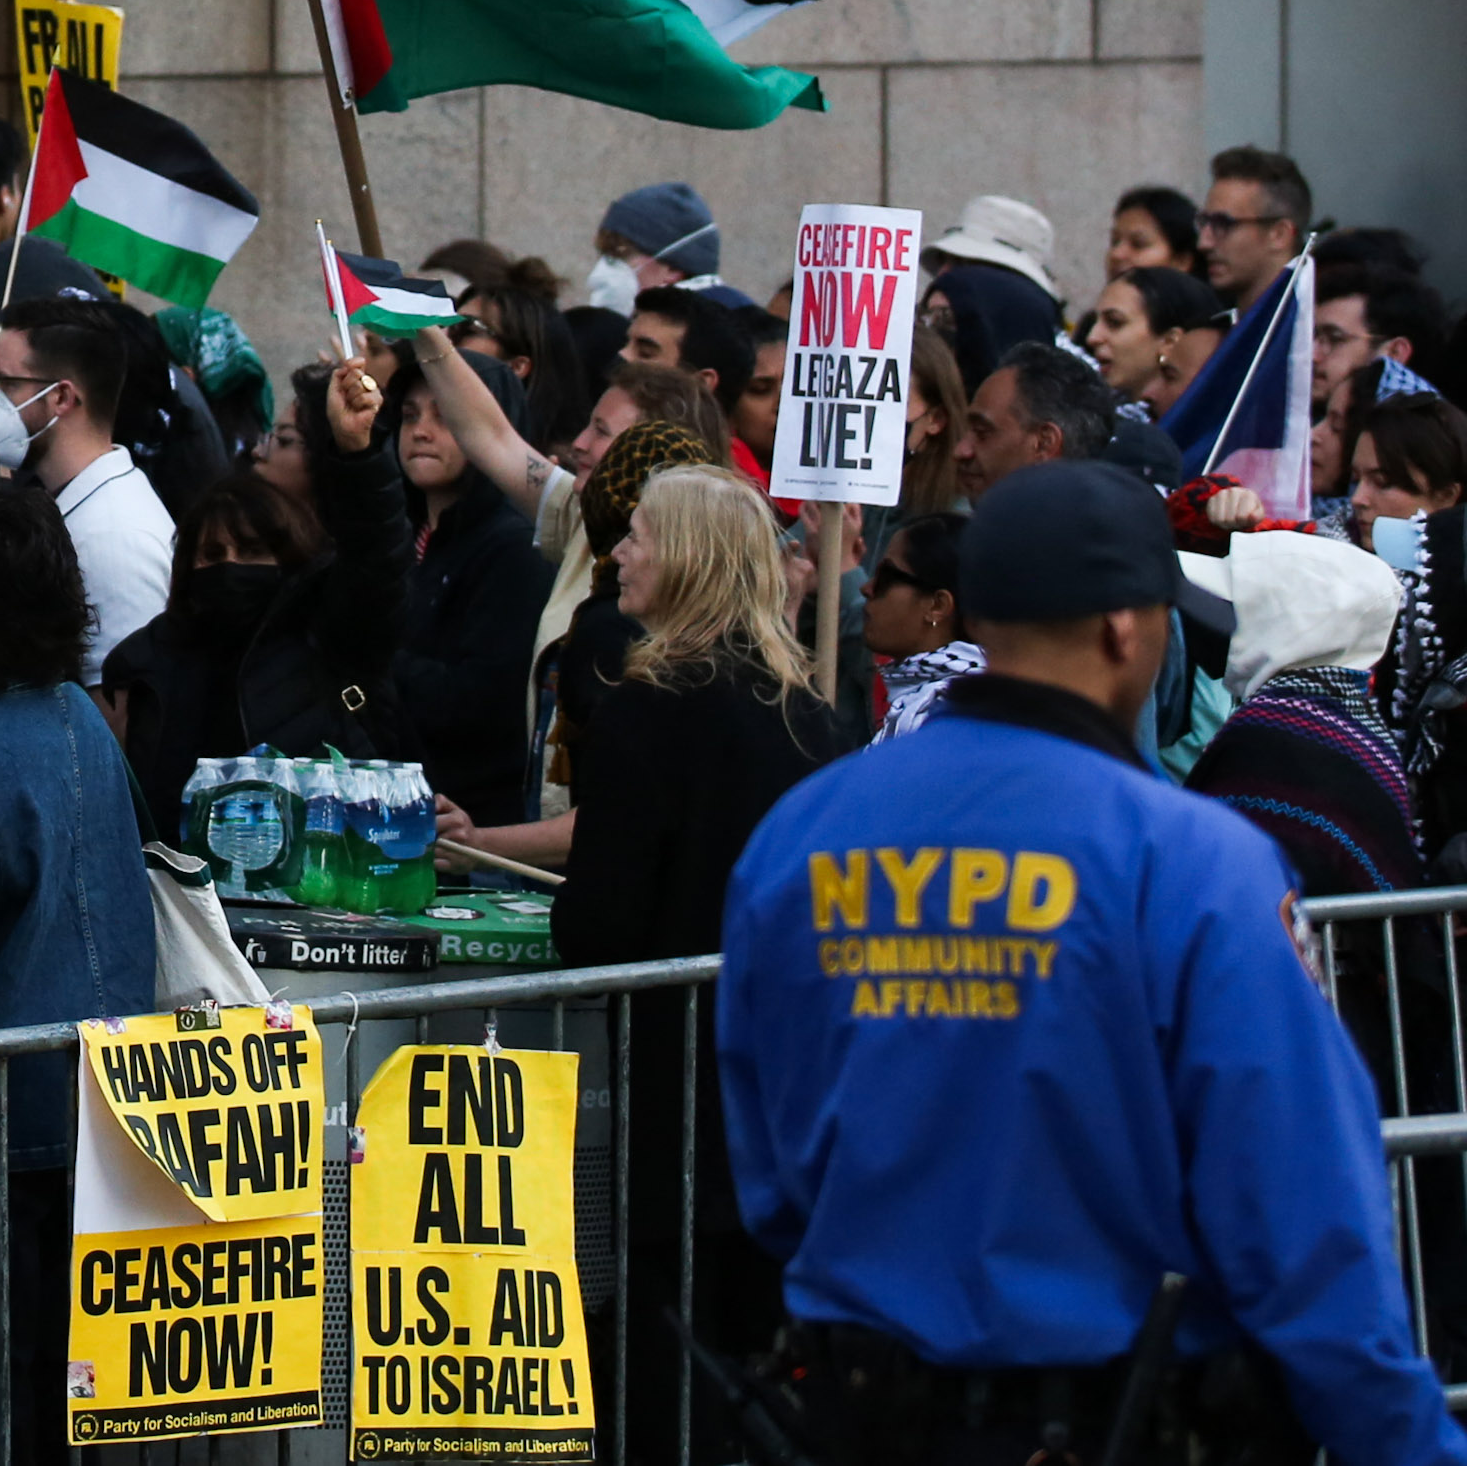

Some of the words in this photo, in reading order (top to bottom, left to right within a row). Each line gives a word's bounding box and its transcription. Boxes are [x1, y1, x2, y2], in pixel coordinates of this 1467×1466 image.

[798, 223, 913, 271] CEASEFIRE
[799, 270, 898, 350] NOW
[823, 353, 902, 402] GAZA
[799, 401, 877, 470] LVE!
[809, 847, 1077, 931] NYPD
[291, 940, 355, 964] Don't
[362, 944, 408, 965] litter
[442, 934, 564, 962] Recycl
[819, 936, 1058, 978] COMMUNITY
[850, 980, 1020, 1019] AFFAIRS
[103, 1036, 237, 1104] HANDS
[242, 1030, 308, 1093] OFF
[408, 1054, 524, 1148] END
[123, 1100, 311, 1198] RAFAH!
[414, 1152, 525, 1247] ALL
[80, 1234, 316, 1316] CEASEFIRE
[366, 1266, 469, 1346] U.S.
[489, 1267, 565, 1348] AID
[128, 1311, 273, 1398] NOW!
[363, 1356, 414, 1415] TO
[421, 1356, 578, 1416] ISRAEL!
[103, 1418, 140, 1435] Party
[144, 1417, 162, 1430] for
[165, 1410, 227, 1429] Socialism
[231, 1406, 255, 1422] and
[257, 1401, 317, 1421] Liberation
[384, 1437, 415, 1455] Party
[417, 1438, 430, 1452] for
[433, 1438, 500, 1454] Socialism
[505, 1441, 524, 1453] and
[525, 1438, 589, 1454] Liberation
